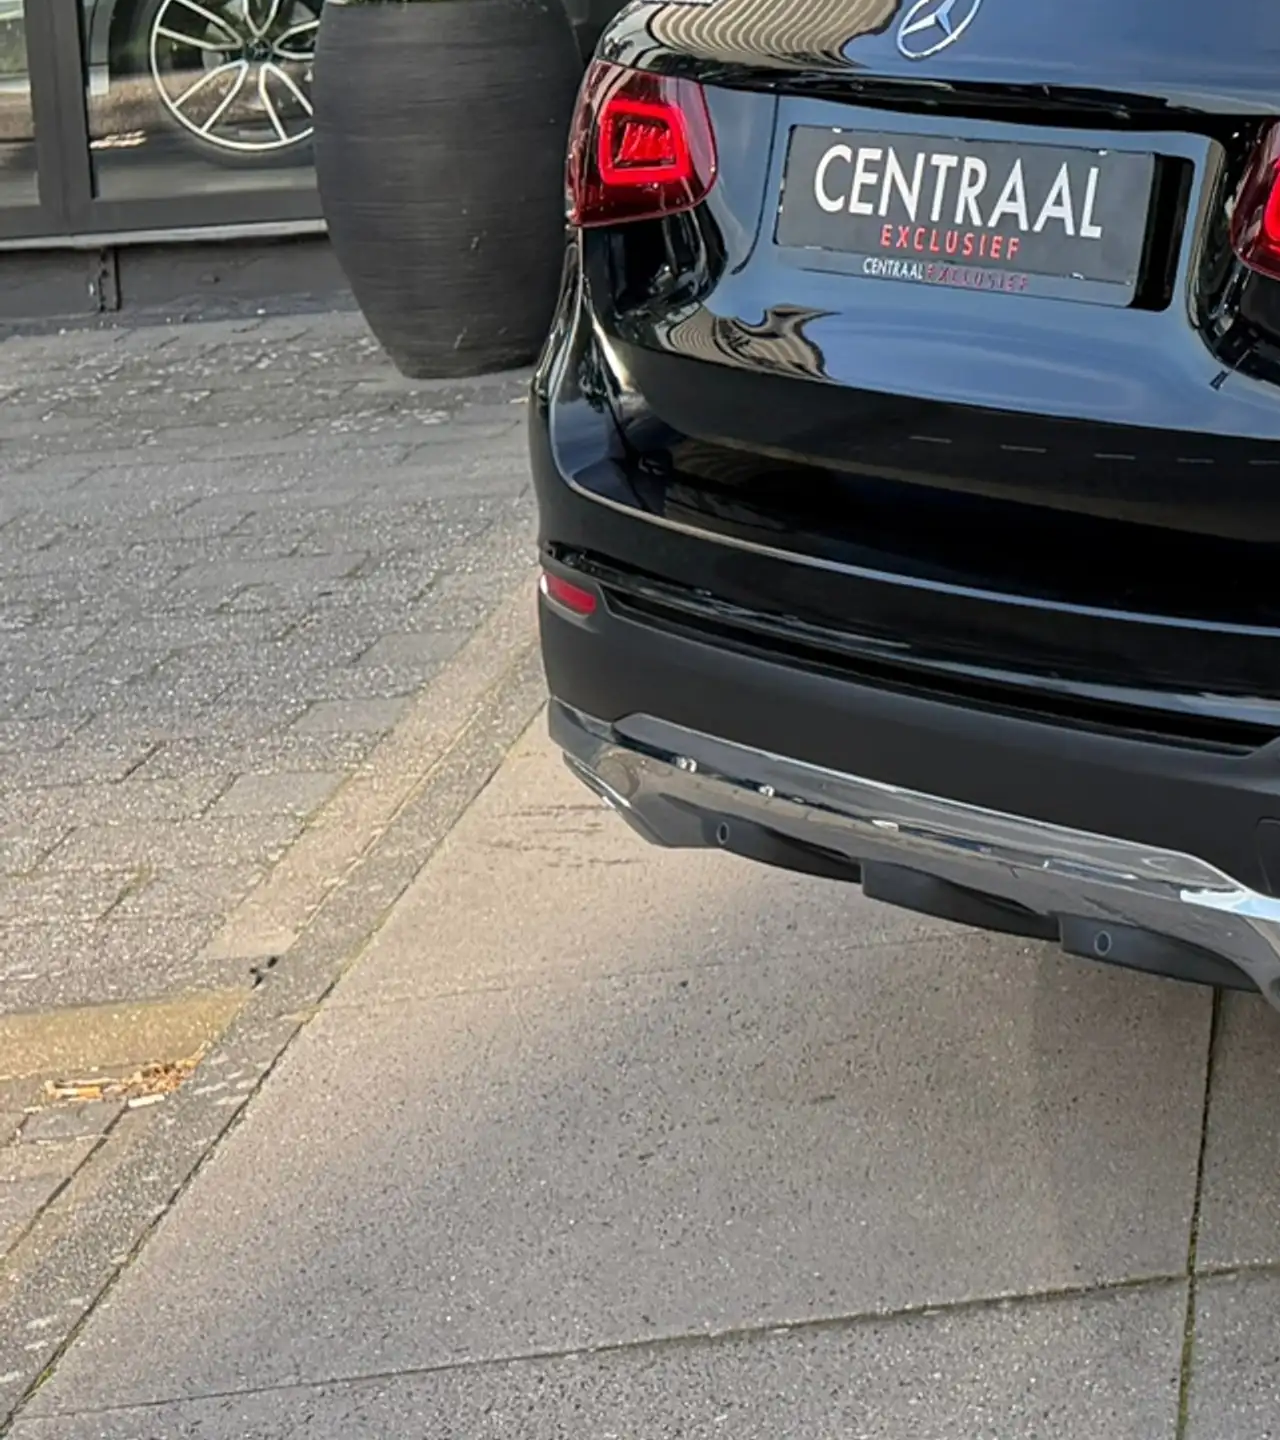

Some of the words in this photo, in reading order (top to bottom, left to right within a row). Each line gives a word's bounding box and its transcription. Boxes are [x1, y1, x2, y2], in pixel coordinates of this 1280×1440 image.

[814, 144, 1103, 239] CENTRAAL
[880, 223, 1021, 260] EXCLUSIEF
[862, 257, 924, 280] CENTRAAL
[926, 263, 1030, 292] EXCLUSIEF
